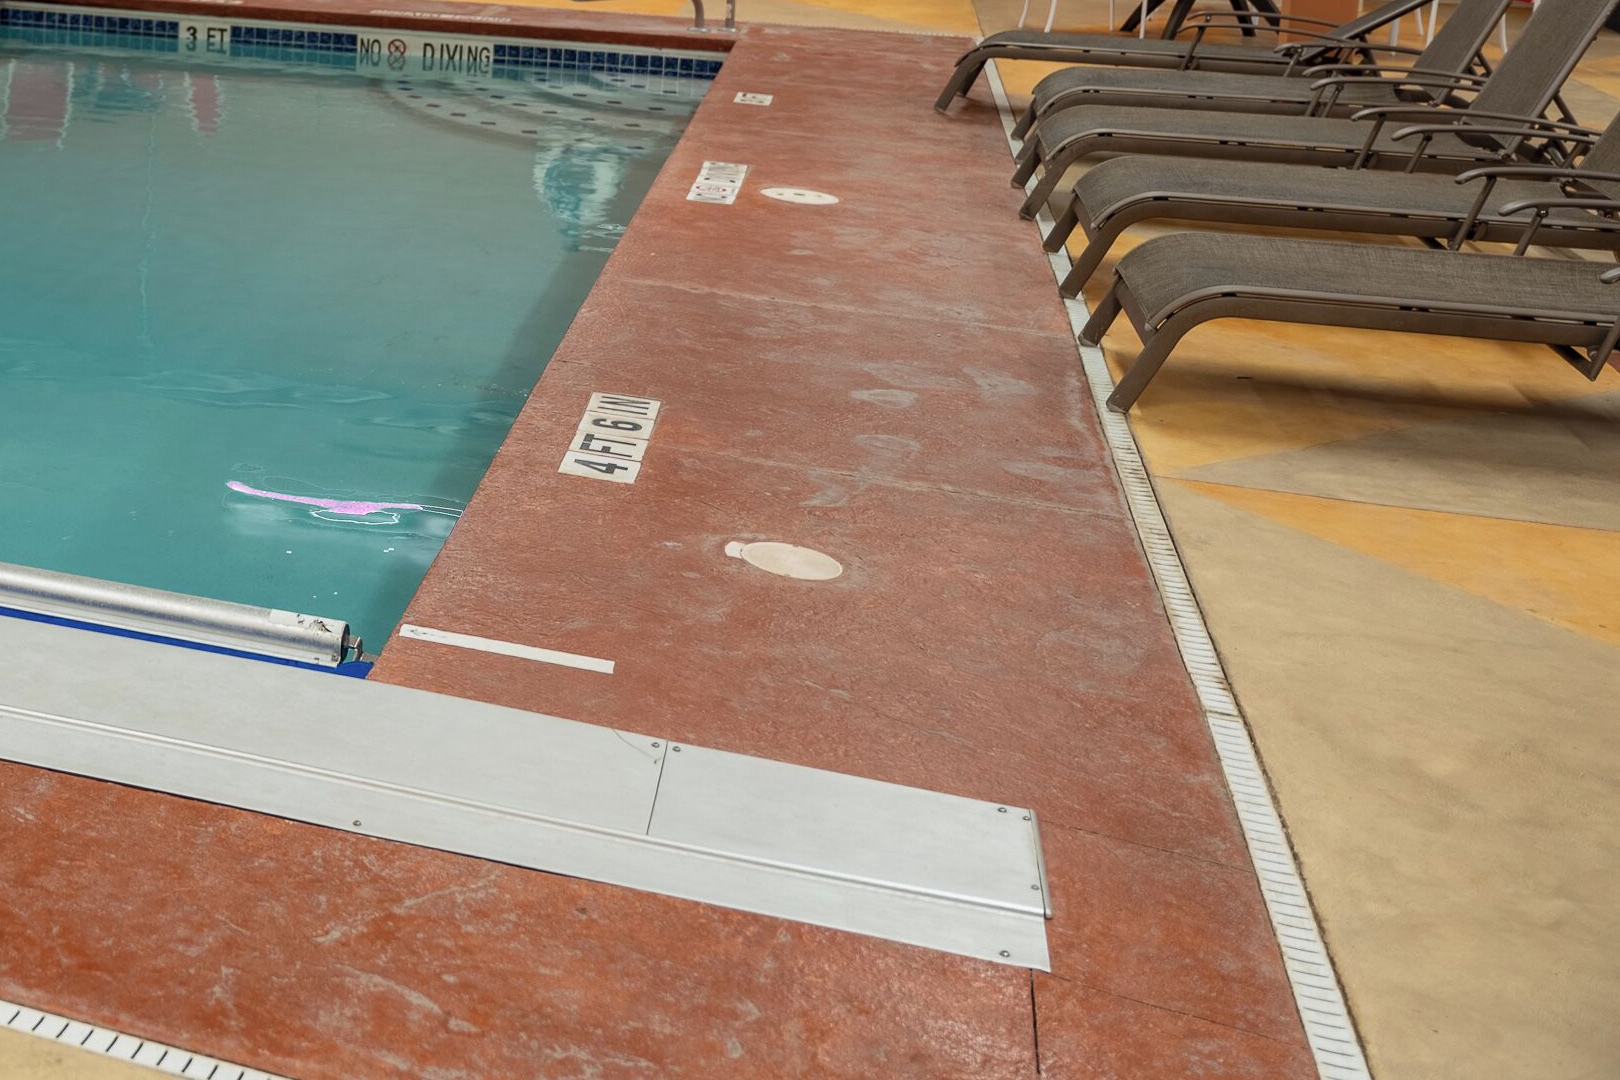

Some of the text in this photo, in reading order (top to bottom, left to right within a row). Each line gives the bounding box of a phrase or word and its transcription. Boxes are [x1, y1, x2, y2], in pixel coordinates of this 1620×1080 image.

[360, 38, 382, 56] NO
[574, 395, 651, 475] 4 FT 6 IN
